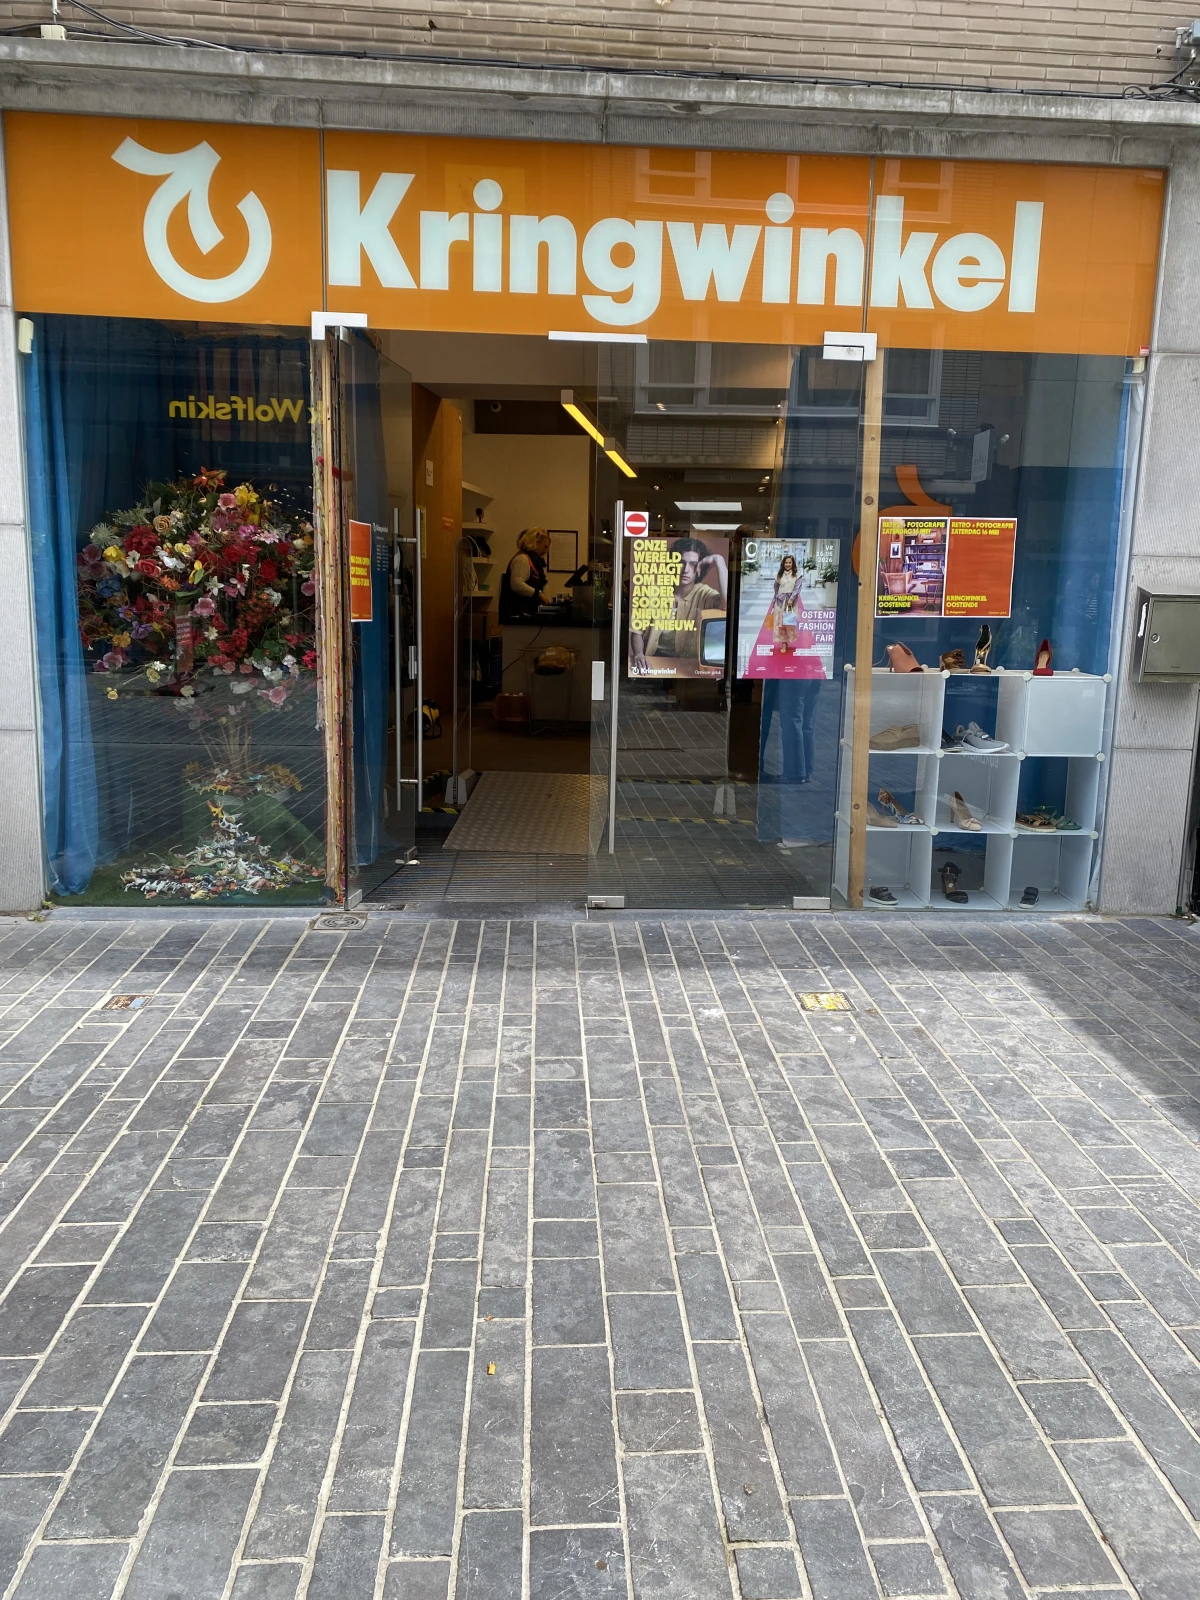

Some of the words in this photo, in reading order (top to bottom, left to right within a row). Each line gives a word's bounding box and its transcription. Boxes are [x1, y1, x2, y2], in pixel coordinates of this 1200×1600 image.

[326, 168, 1044, 326] Kringwinkel
[633, 540, 667, 552] ONZE
[633, 552, 682, 563] WERELD
[633, 563, 683, 574] VRAAGT
[633, 574, 657, 586] OM
[657, 575, 680, 586] EEN
[633, 586, 674, 597] ANDER
[632, 597, 675, 608] SOORT
[632, 608, 676, 619] NIEUW:
[632, 619, 697, 631] OP-NIEUW.
[798, 622, 834, 630] FASHION
[641, 667, 676, 676] Kringwinkel
